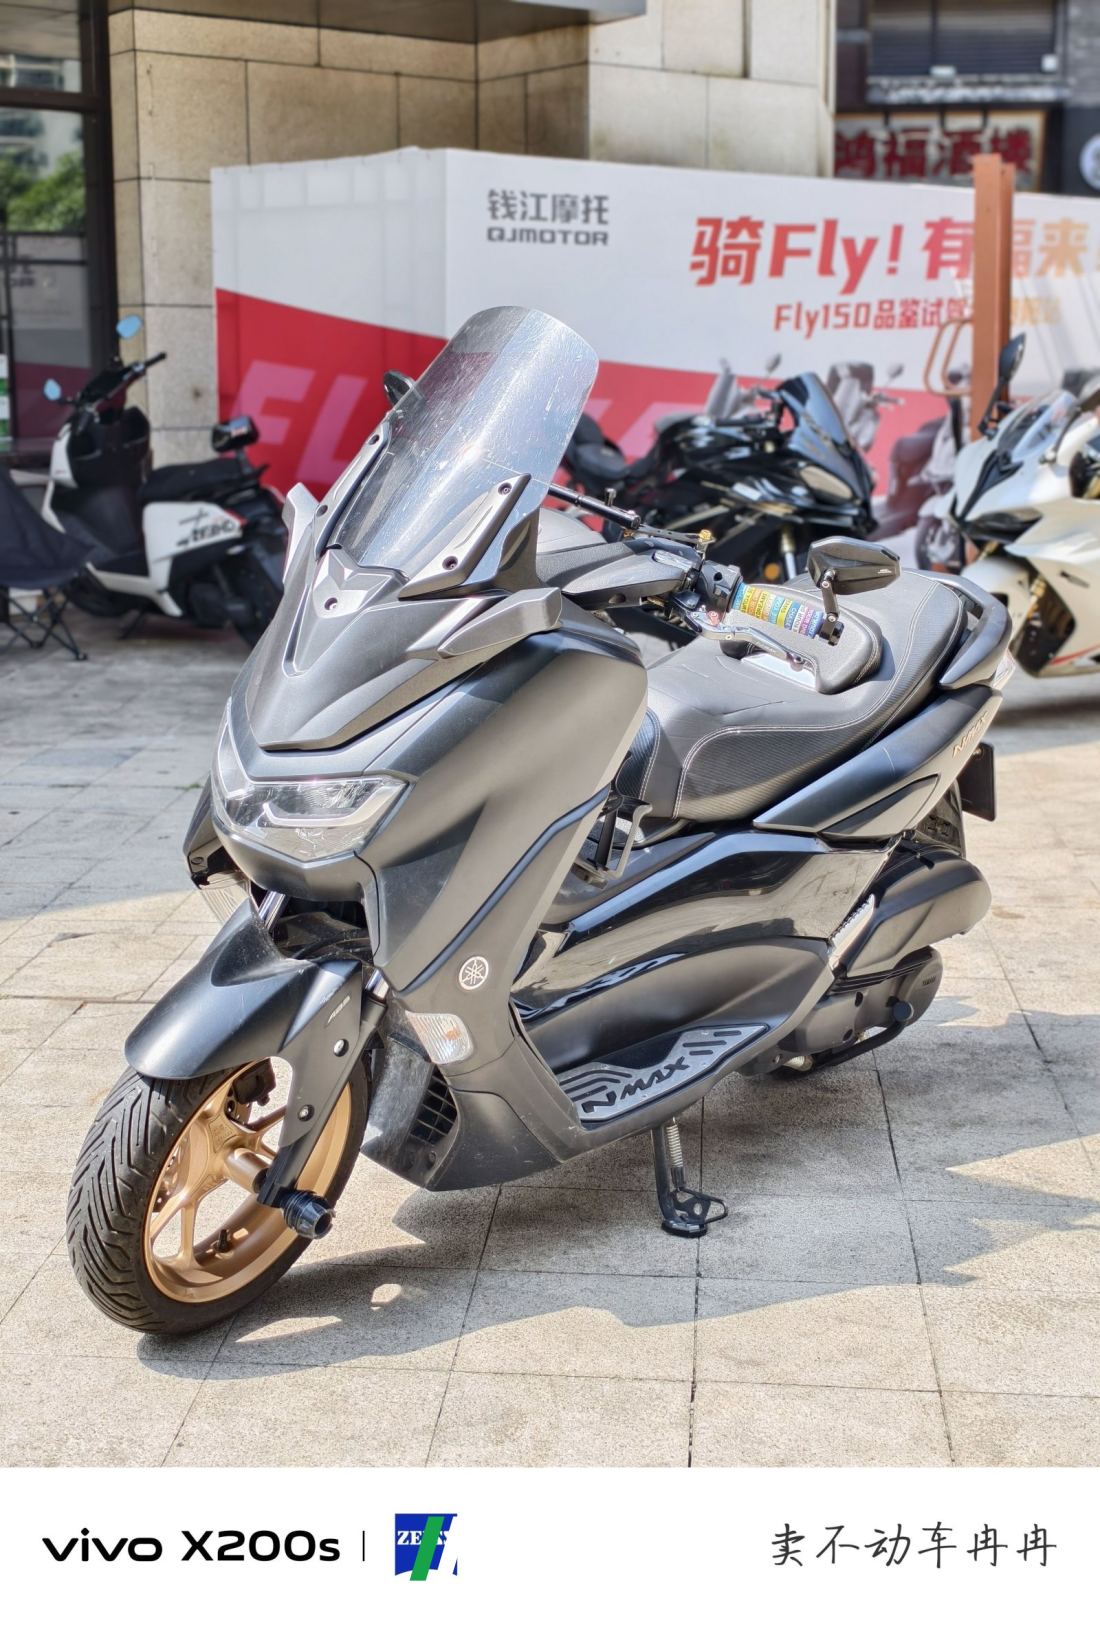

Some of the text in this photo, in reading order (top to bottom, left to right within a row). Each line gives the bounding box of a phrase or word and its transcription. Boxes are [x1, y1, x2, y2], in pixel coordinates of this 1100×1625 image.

[487, 189, 609, 225] 钱江摩托
[487, 226, 609, 246] QJMOTOR
[581, 1056, 690, 1113] NMAX
